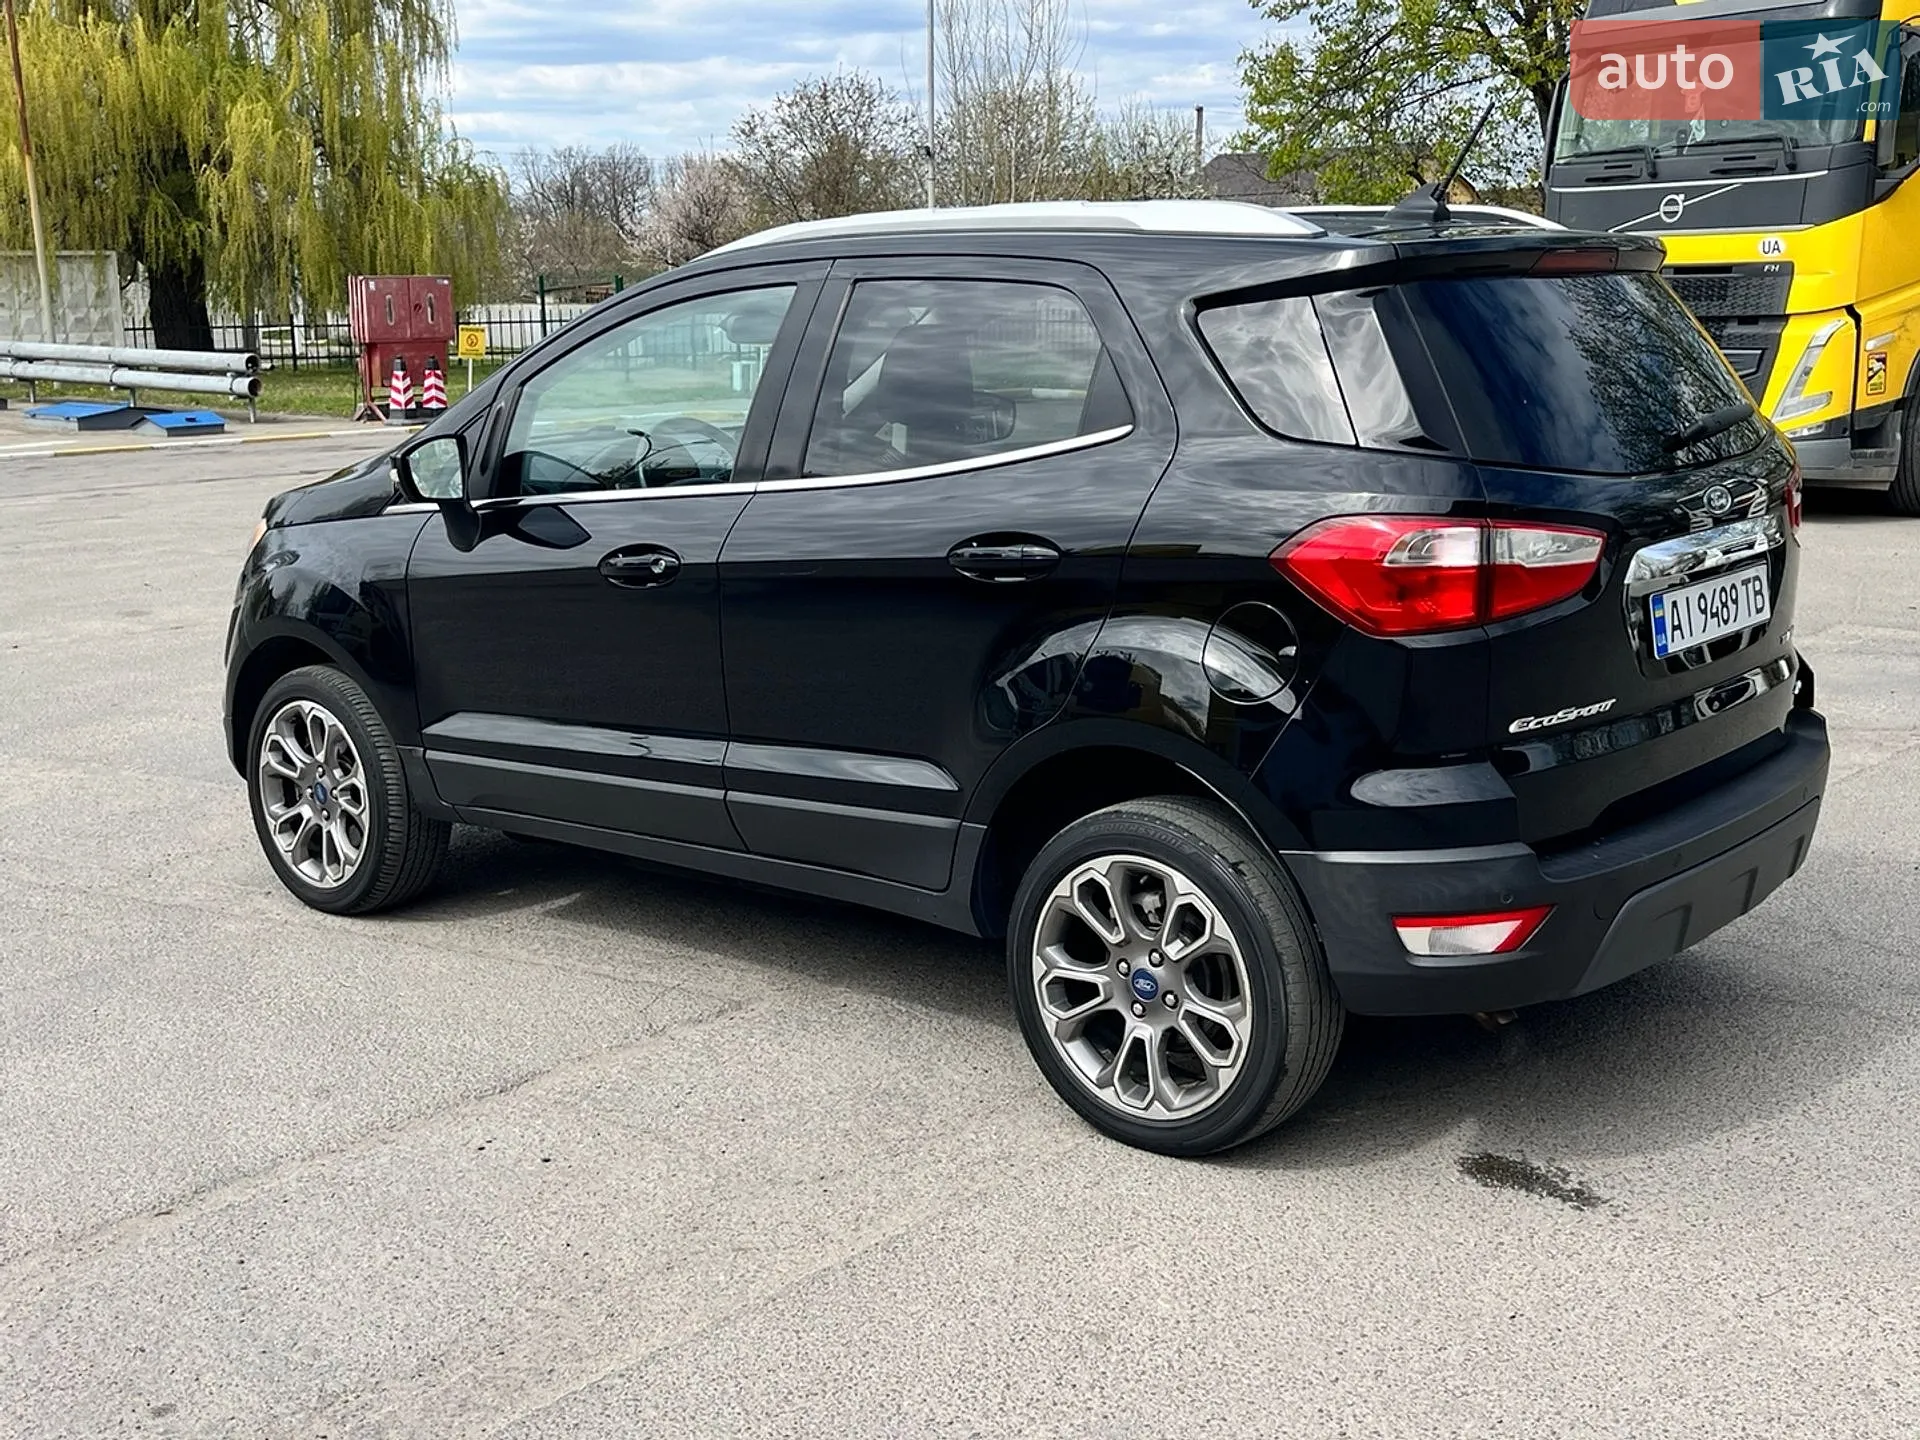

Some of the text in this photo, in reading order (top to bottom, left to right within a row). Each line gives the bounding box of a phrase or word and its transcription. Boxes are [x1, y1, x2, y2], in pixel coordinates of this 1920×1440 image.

[1762, 240, 1781, 254] UA
[1671, 596, 1693, 643] AI
[1697, 583, 1738, 634] 9489
[1741, 575, 1765, 618] TB
